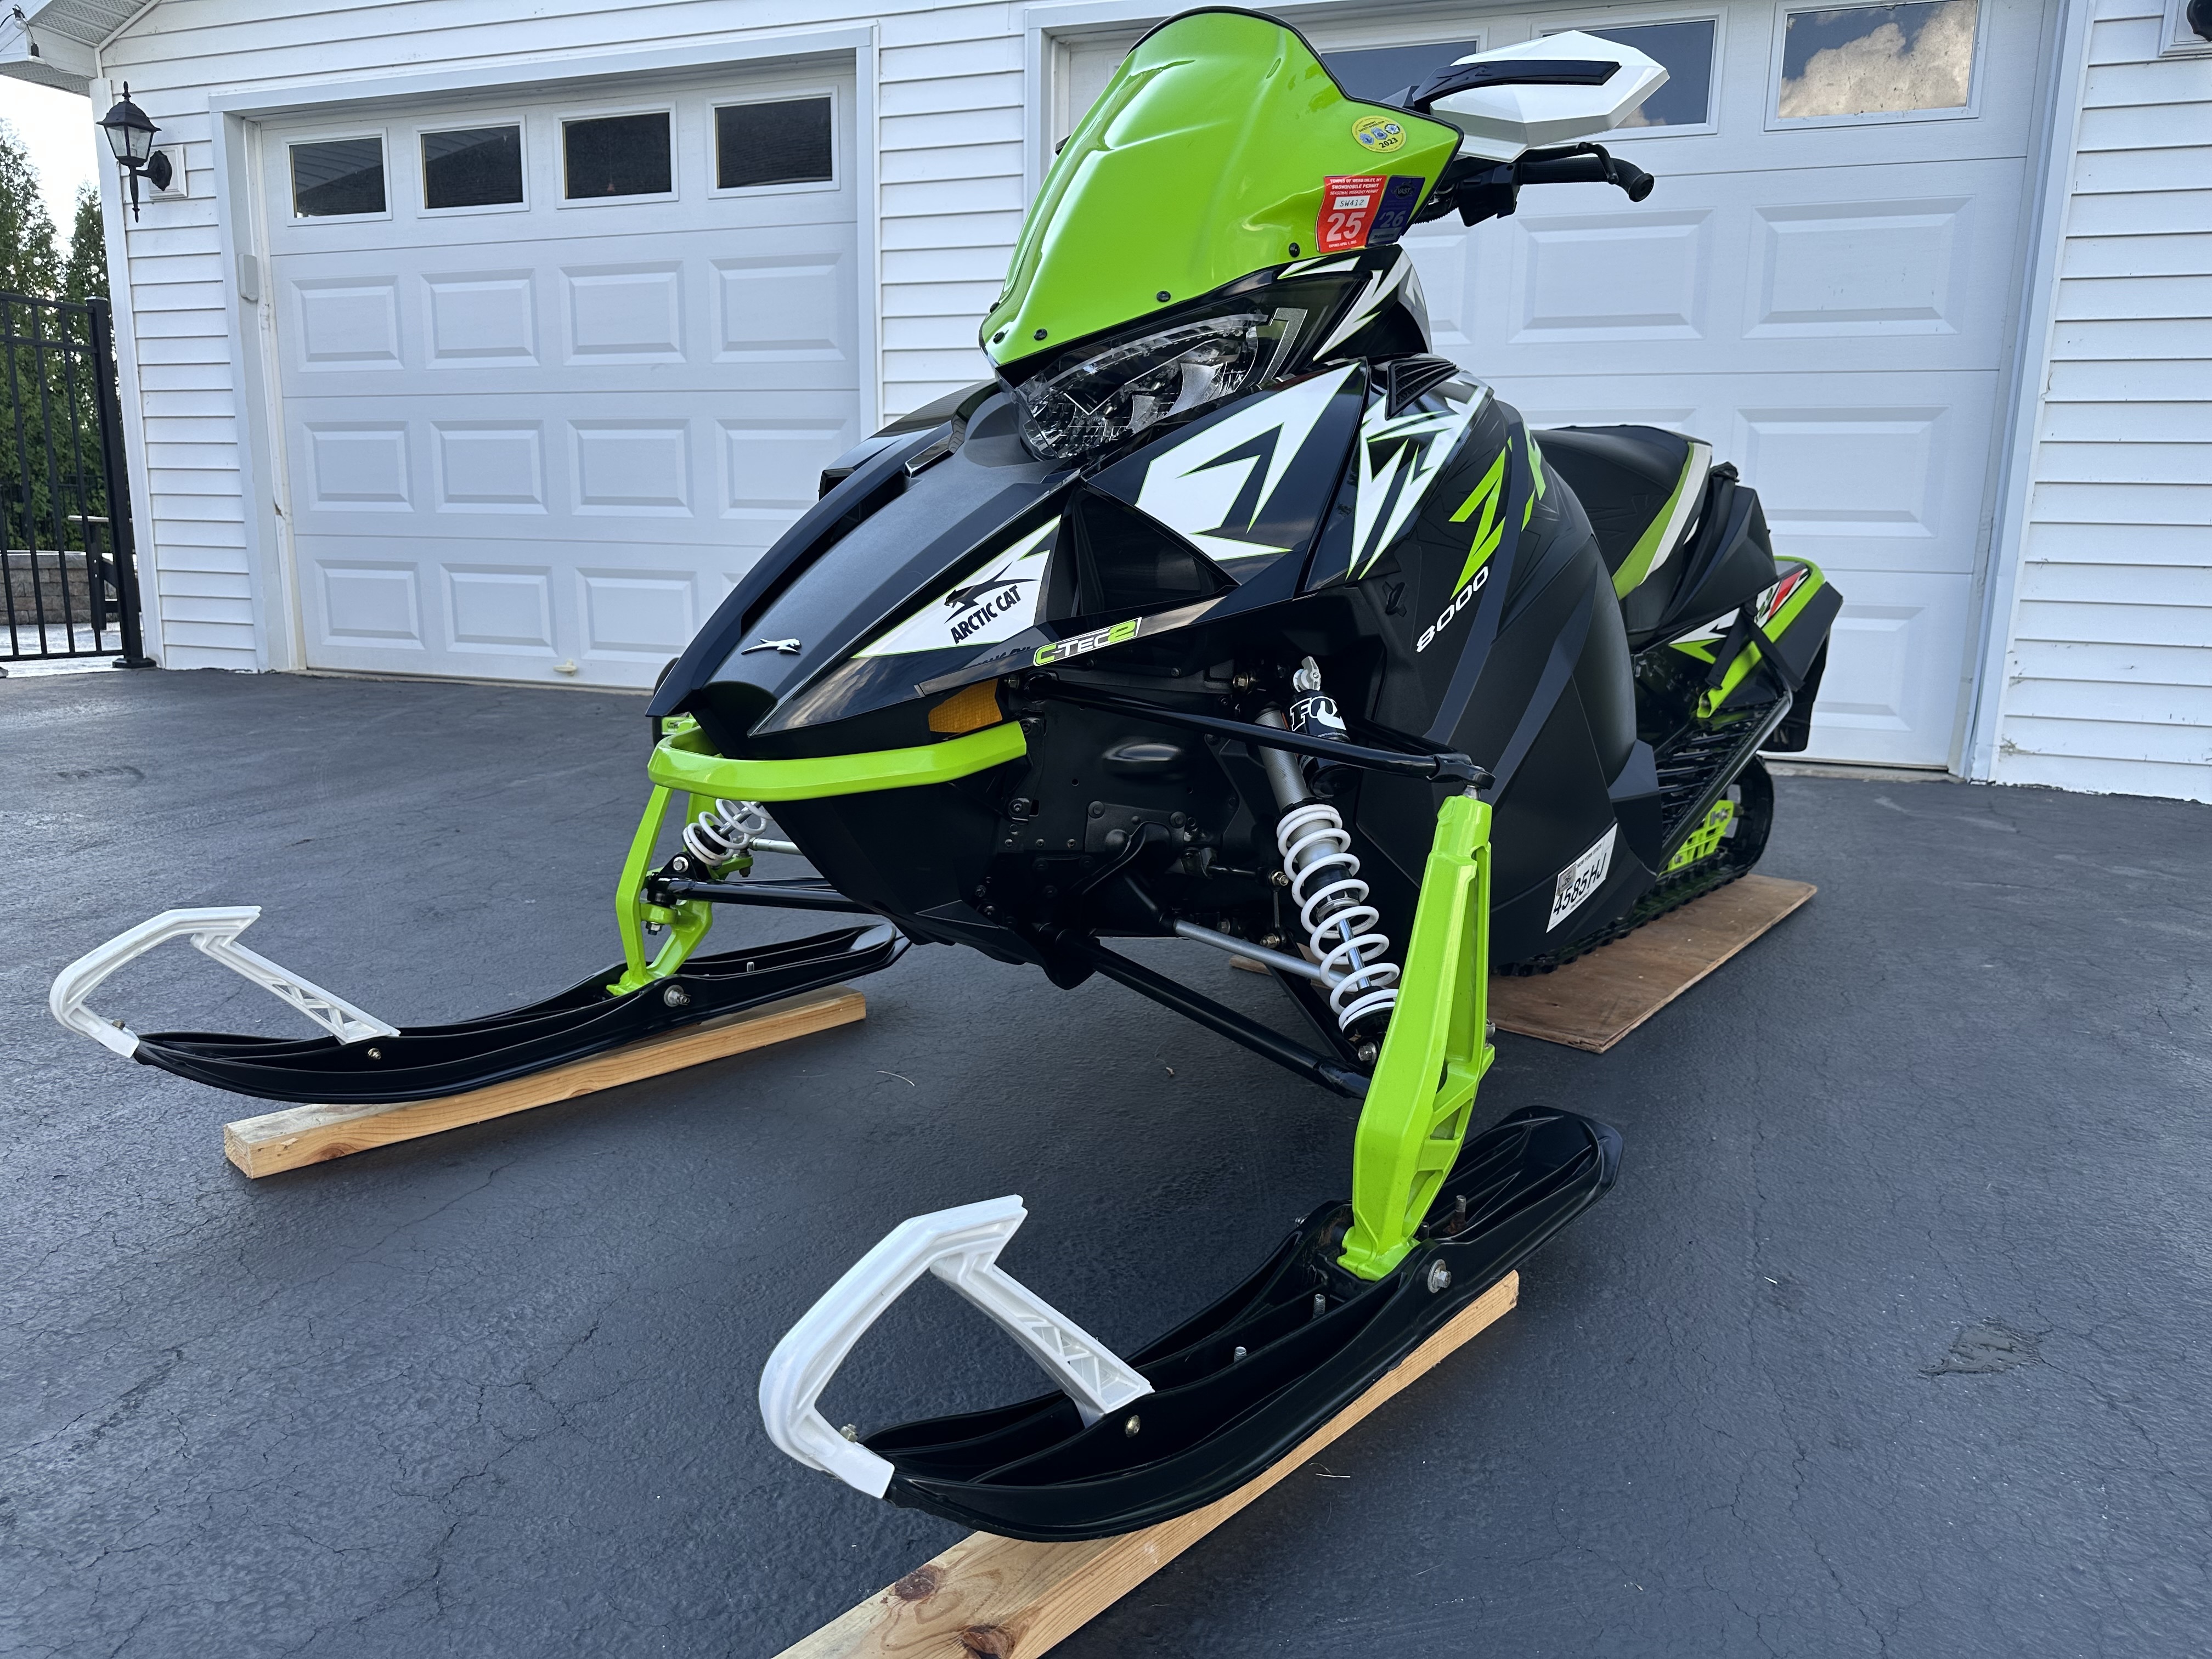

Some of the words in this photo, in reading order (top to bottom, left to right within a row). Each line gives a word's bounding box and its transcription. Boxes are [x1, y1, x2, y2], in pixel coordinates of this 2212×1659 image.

[1379, 137, 1398, 148] 2023
[1327, 212, 1365, 242] 25
[951, 602, 998, 645] ARCTIC
[996, 585, 1021, 611] CAT
[1416, 566, 1488, 652] 8000
[1553, 852, 1607, 915] 4585HJ
